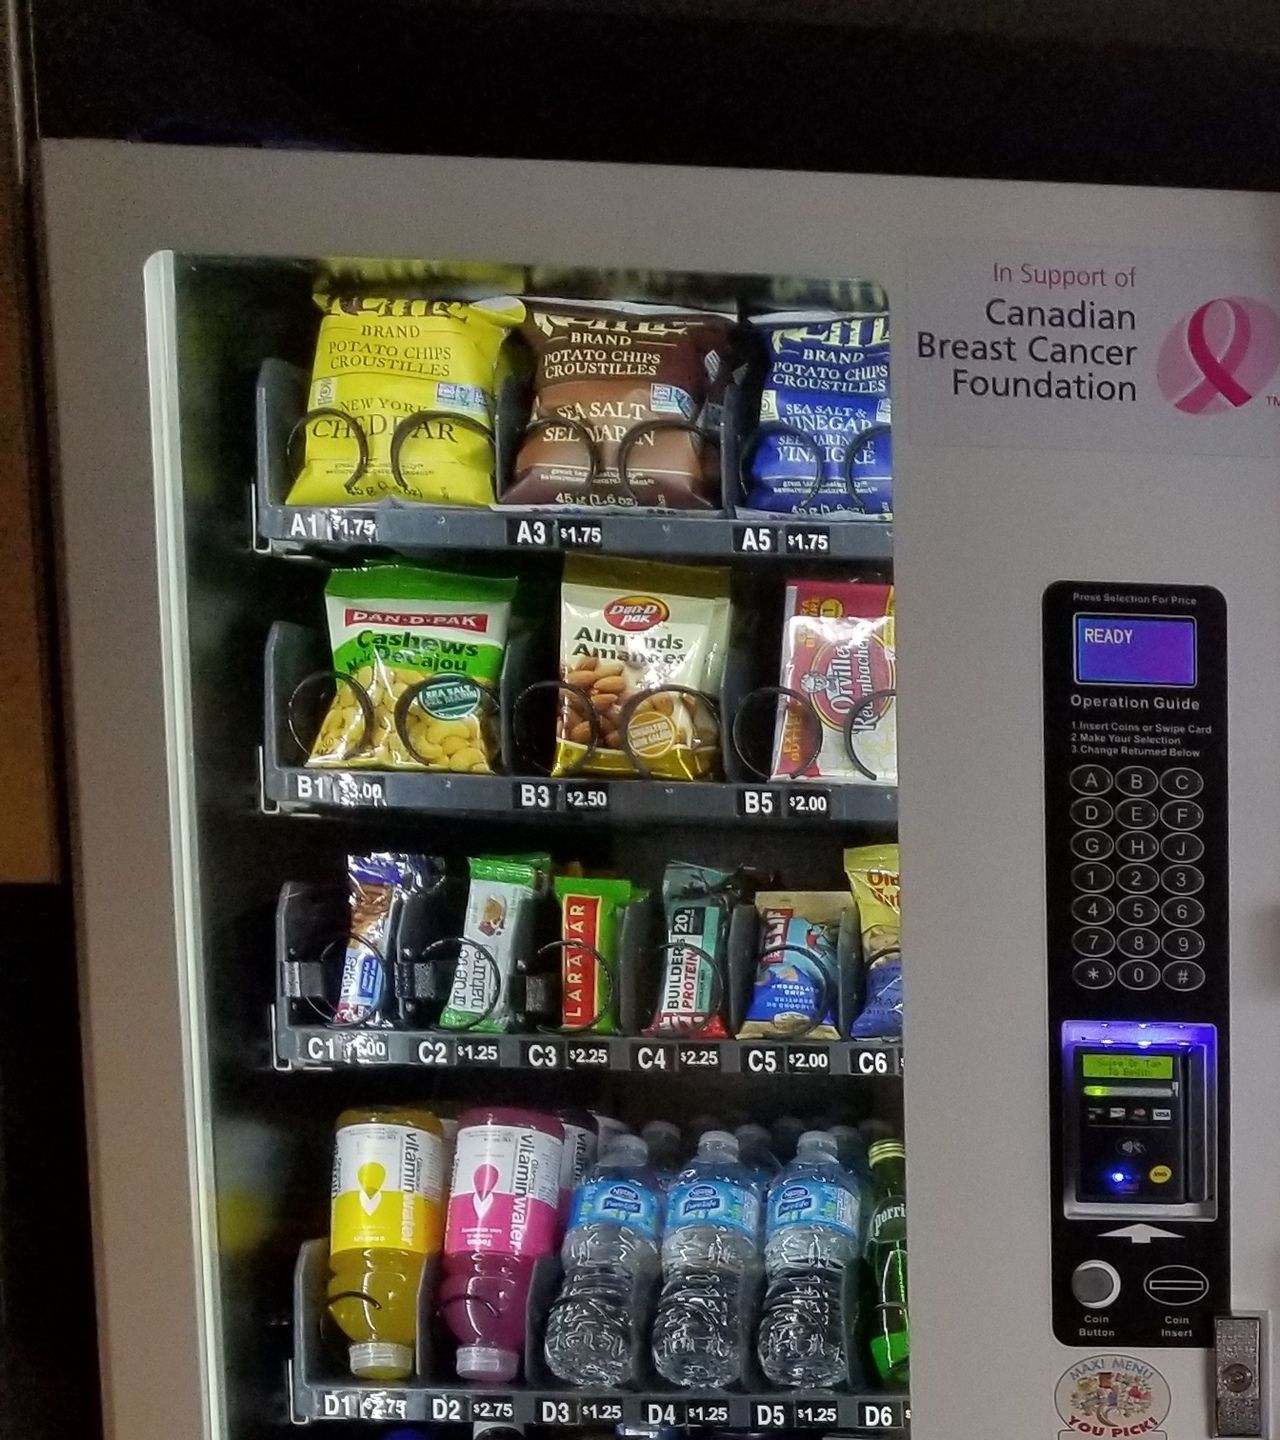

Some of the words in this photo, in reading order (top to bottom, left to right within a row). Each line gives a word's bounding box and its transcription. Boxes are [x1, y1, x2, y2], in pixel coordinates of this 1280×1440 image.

[993, 263, 1012, 283] In
[1021, 264, 1106, 289] Support
[1115, 267, 1137, 287] of
[985, 299, 1136, 330] Canadian
[361, 324, 420, 338] BRAND
[570, 332, 631, 345] BRAND
[329, 341, 398, 356] POTATO
[404, 347, 451, 360] CHIPS
[803, 349, 864, 364] BRAND
[917, 331, 1016, 361] Breast
[1028, 336, 1137, 365] Cancer
[330, 355, 450, 376] CROUSTILLES
[544, 350, 606, 367] POTATO
[611, 351, 661, 364] CHIPS
[545, 362, 657, 379] CROUSTILLES
[773, 362, 839, 380] POTATO
[845, 365, 888, 381] CHIPS
[773, 374, 886, 392] CROUSTILLES
[952, 369, 1137, 401] Foundation
[557, 403, 587, 420] SEA
[589, 402, 646, 420] SALT
[786, 404, 812, 415] SEA
[815, 406, 853, 417] SALT
[543, 427, 580, 442] SEL
[290, 514, 319, 536] A1
[517, 520, 545, 544] A3
[561, 527, 601, 544] $1.75
[742, 528, 771, 551] A5
[788, 534, 828, 550] $1.75
[621, 613, 650, 626] pak
[357, 630, 479, 657] Cashews
[1085, 628, 1133, 644] READY
[1071, 694, 1149, 709] Operation
[1154, 697, 1200, 710] Guide
[1111, 722, 1140, 732] Coins
[1155, 724, 1185, 735] Swipe
[1188, 724, 1212, 734] Card
[1108, 734, 1131, 743] Your
[1134, 735, 1181, 745] Selection
[1121, 746, 1167, 756] Returned
[1169, 748, 1200, 757] Below
[297, 775, 323, 798] B1
[521, 784, 550, 806] B3
[567, 791, 607, 806] $2.50
[745, 792, 773, 814] B5
[789, 796, 827, 812] $2.00
[308, 1036, 333, 1059] C1
[419, 1042, 447, 1063] C2
[458, 1045, 498, 1061] $1.25
[528, 1045, 557, 1067] C3
[569, 1049, 608, 1063] $2.25
[638, 1047, 666, 1069] C4
[680, 1051, 719, 1065] $2.25
[749, 1050, 776, 1071] C5
[789, 1053, 827, 1068] $2.00
[859, 1052, 887, 1073] C6
[511, 1135, 533, 1253] vitaminwater
[1084, 1315, 1109, 1324] Coin
[1165, 1315, 1189, 1325] Coin
[1079, 1328, 1115, 1337] Button
[1161, 1328, 1193, 1337] Insert
[1069, 1358, 1106, 1381] MAXI
[1112, 1358, 1154, 1379] MENU
[325, 1395, 350, 1416] D1
[432, 1400, 460, 1420] D2
[473, 1403, 512, 1418] $2.75
[542, 1403, 569, 1423] D3
[583, 1404, 621, 1420] $1.25
[689, 1406, 728, 1422] $1.25
[648, 1405, 676, 1426] D4
[757, 1406, 785, 1427] D5
[798, 1407, 836, 1423] $1.25
[865, 1407, 893, 1427] D6
[1068, 1416, 1105, 1436] YOU
[1112, 1416, 1158, 1438] PICK!
